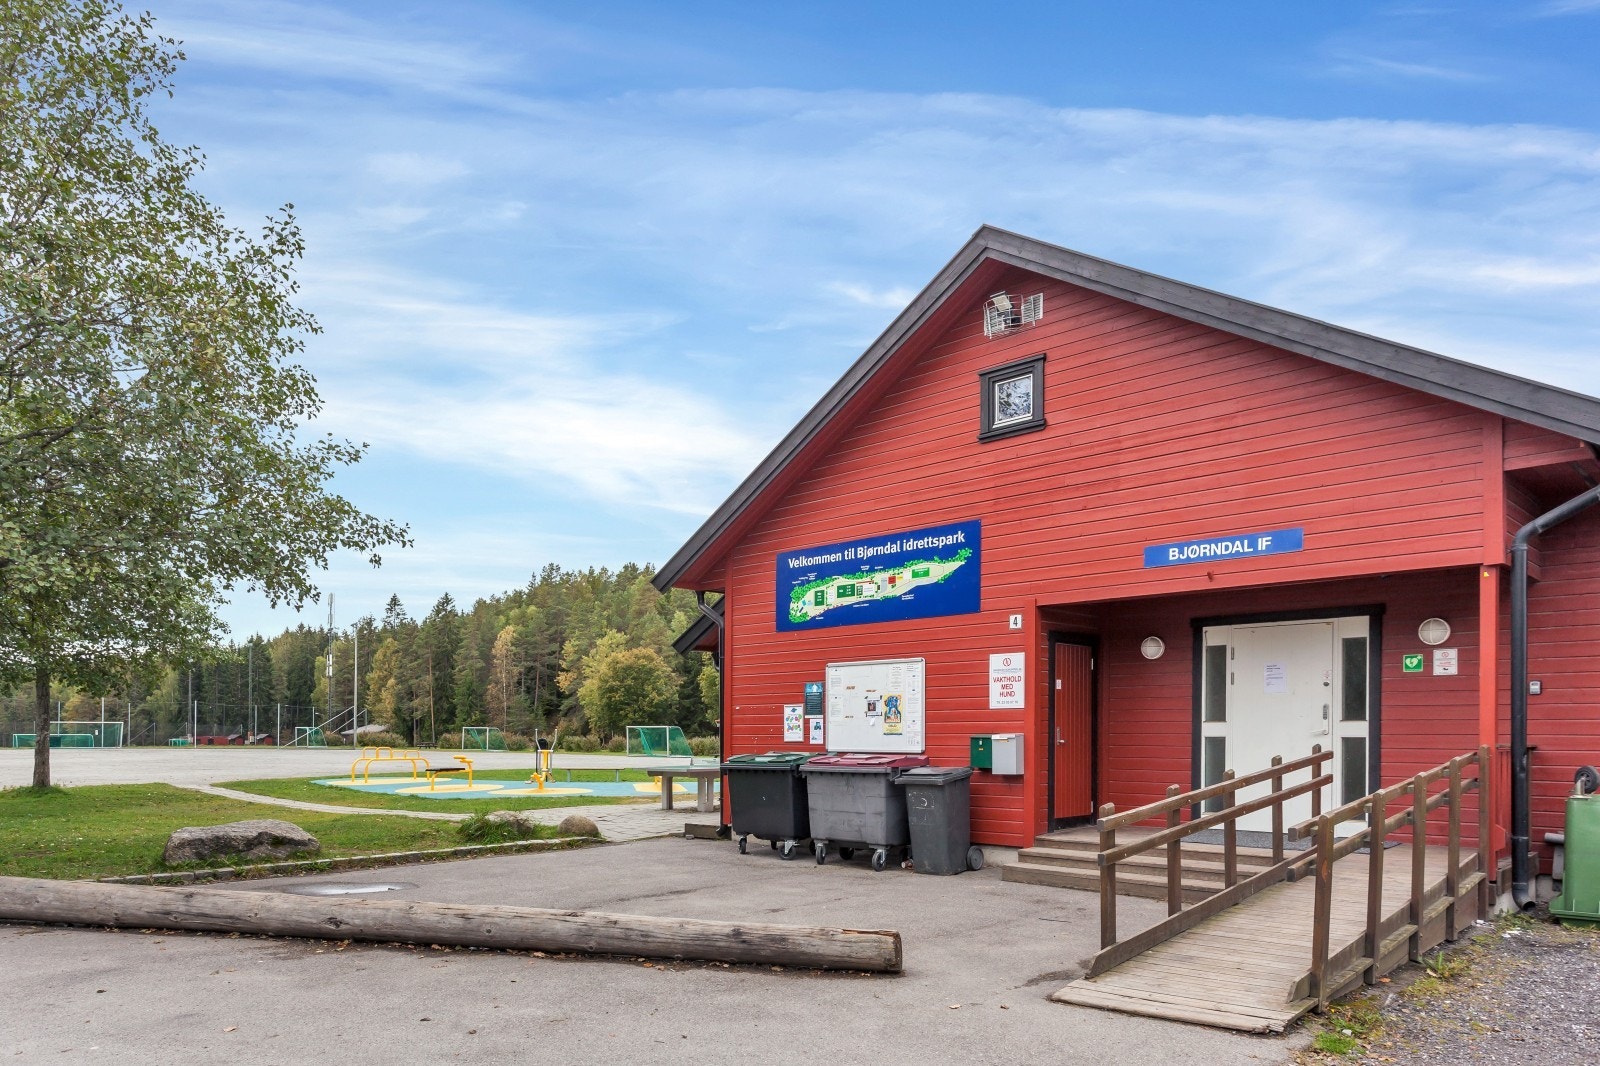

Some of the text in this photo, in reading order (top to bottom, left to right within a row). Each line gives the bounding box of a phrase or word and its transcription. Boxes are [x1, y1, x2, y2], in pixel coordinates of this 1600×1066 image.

[788, 531, 965, 568] Velkommen til Bjørndal idrettspark
[1169, 537, 1272, 560] BJØRNDAL IF
[1013, 616, 1018, 627] 4
[993, 675, 1021, 683] VAKTHOLD
